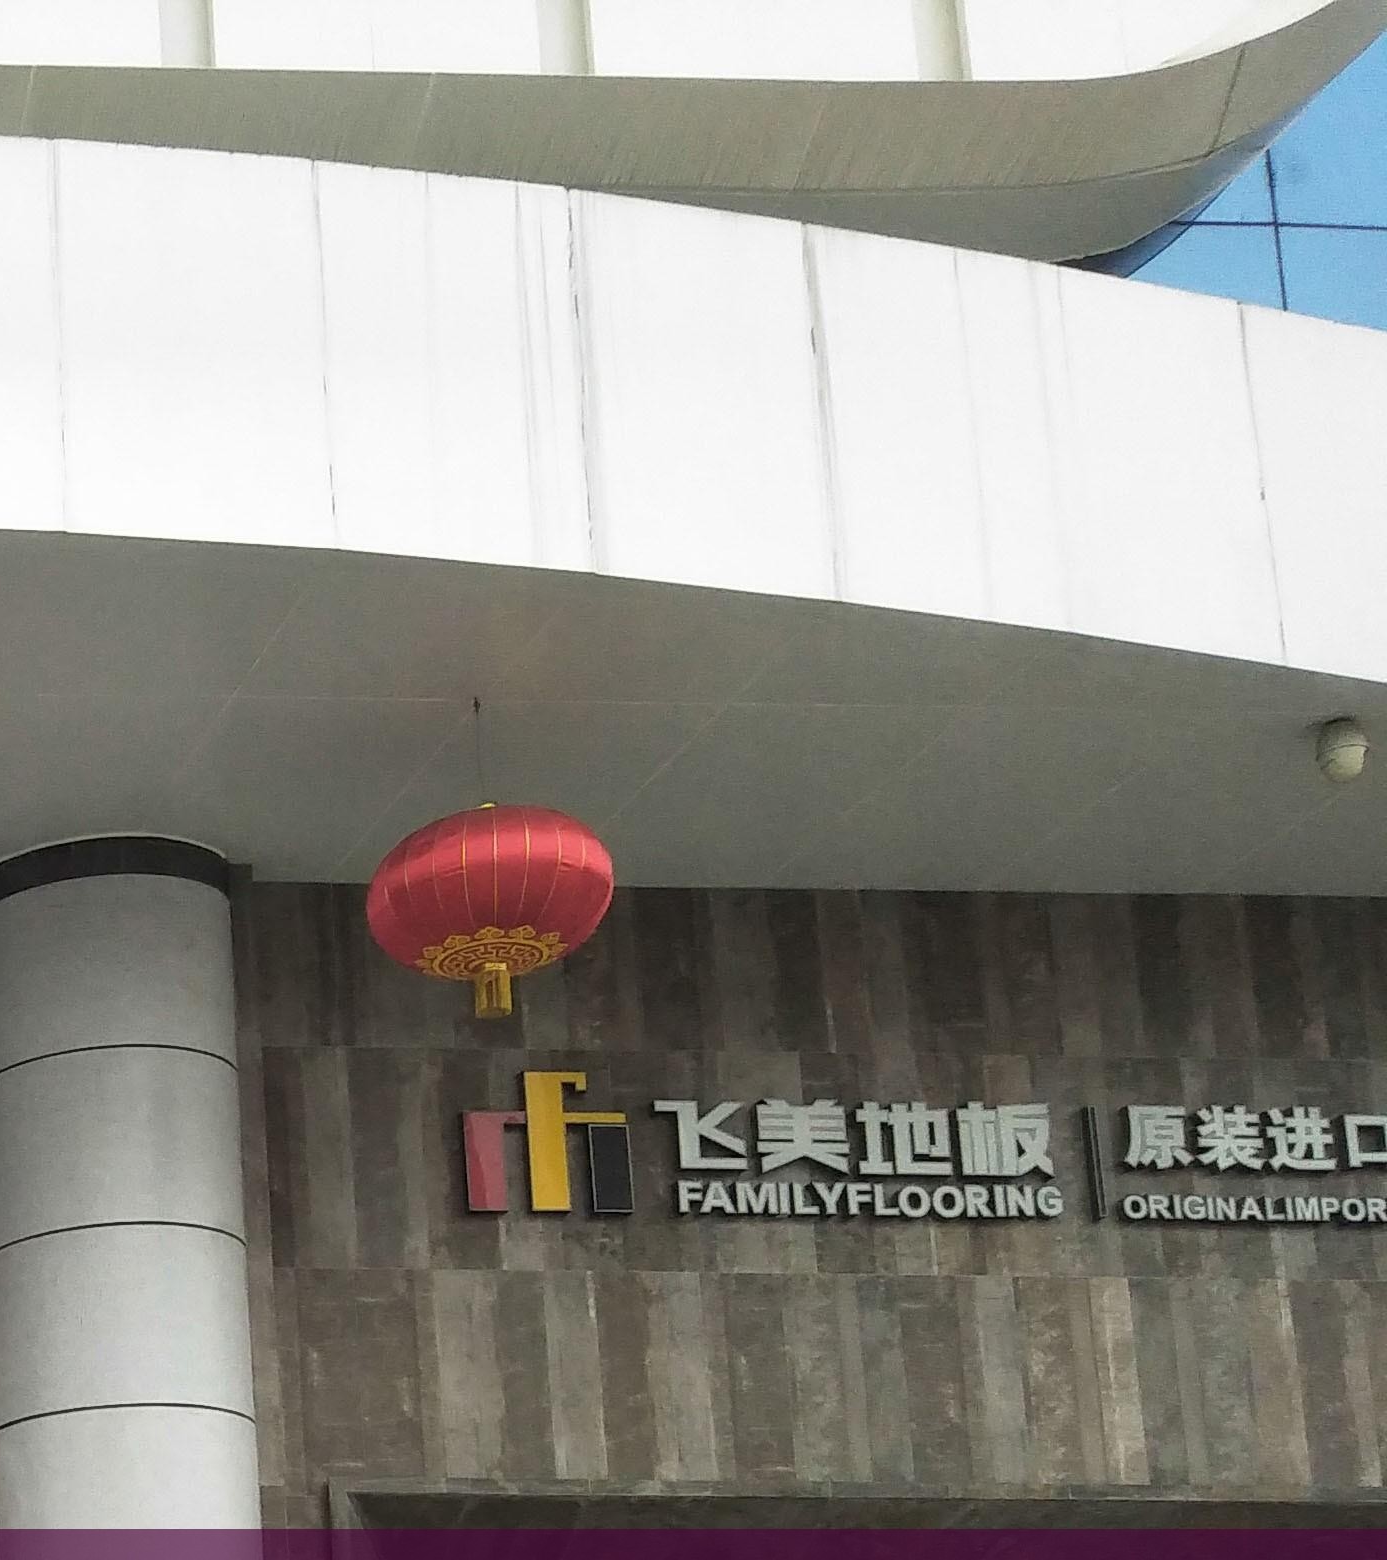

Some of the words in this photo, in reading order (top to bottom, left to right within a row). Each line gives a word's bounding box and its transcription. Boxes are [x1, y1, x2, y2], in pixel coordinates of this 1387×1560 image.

[653, 1098, 1056, 1179] 飞美地板
[1123, 1104, 1387, 1171] 原装进口
